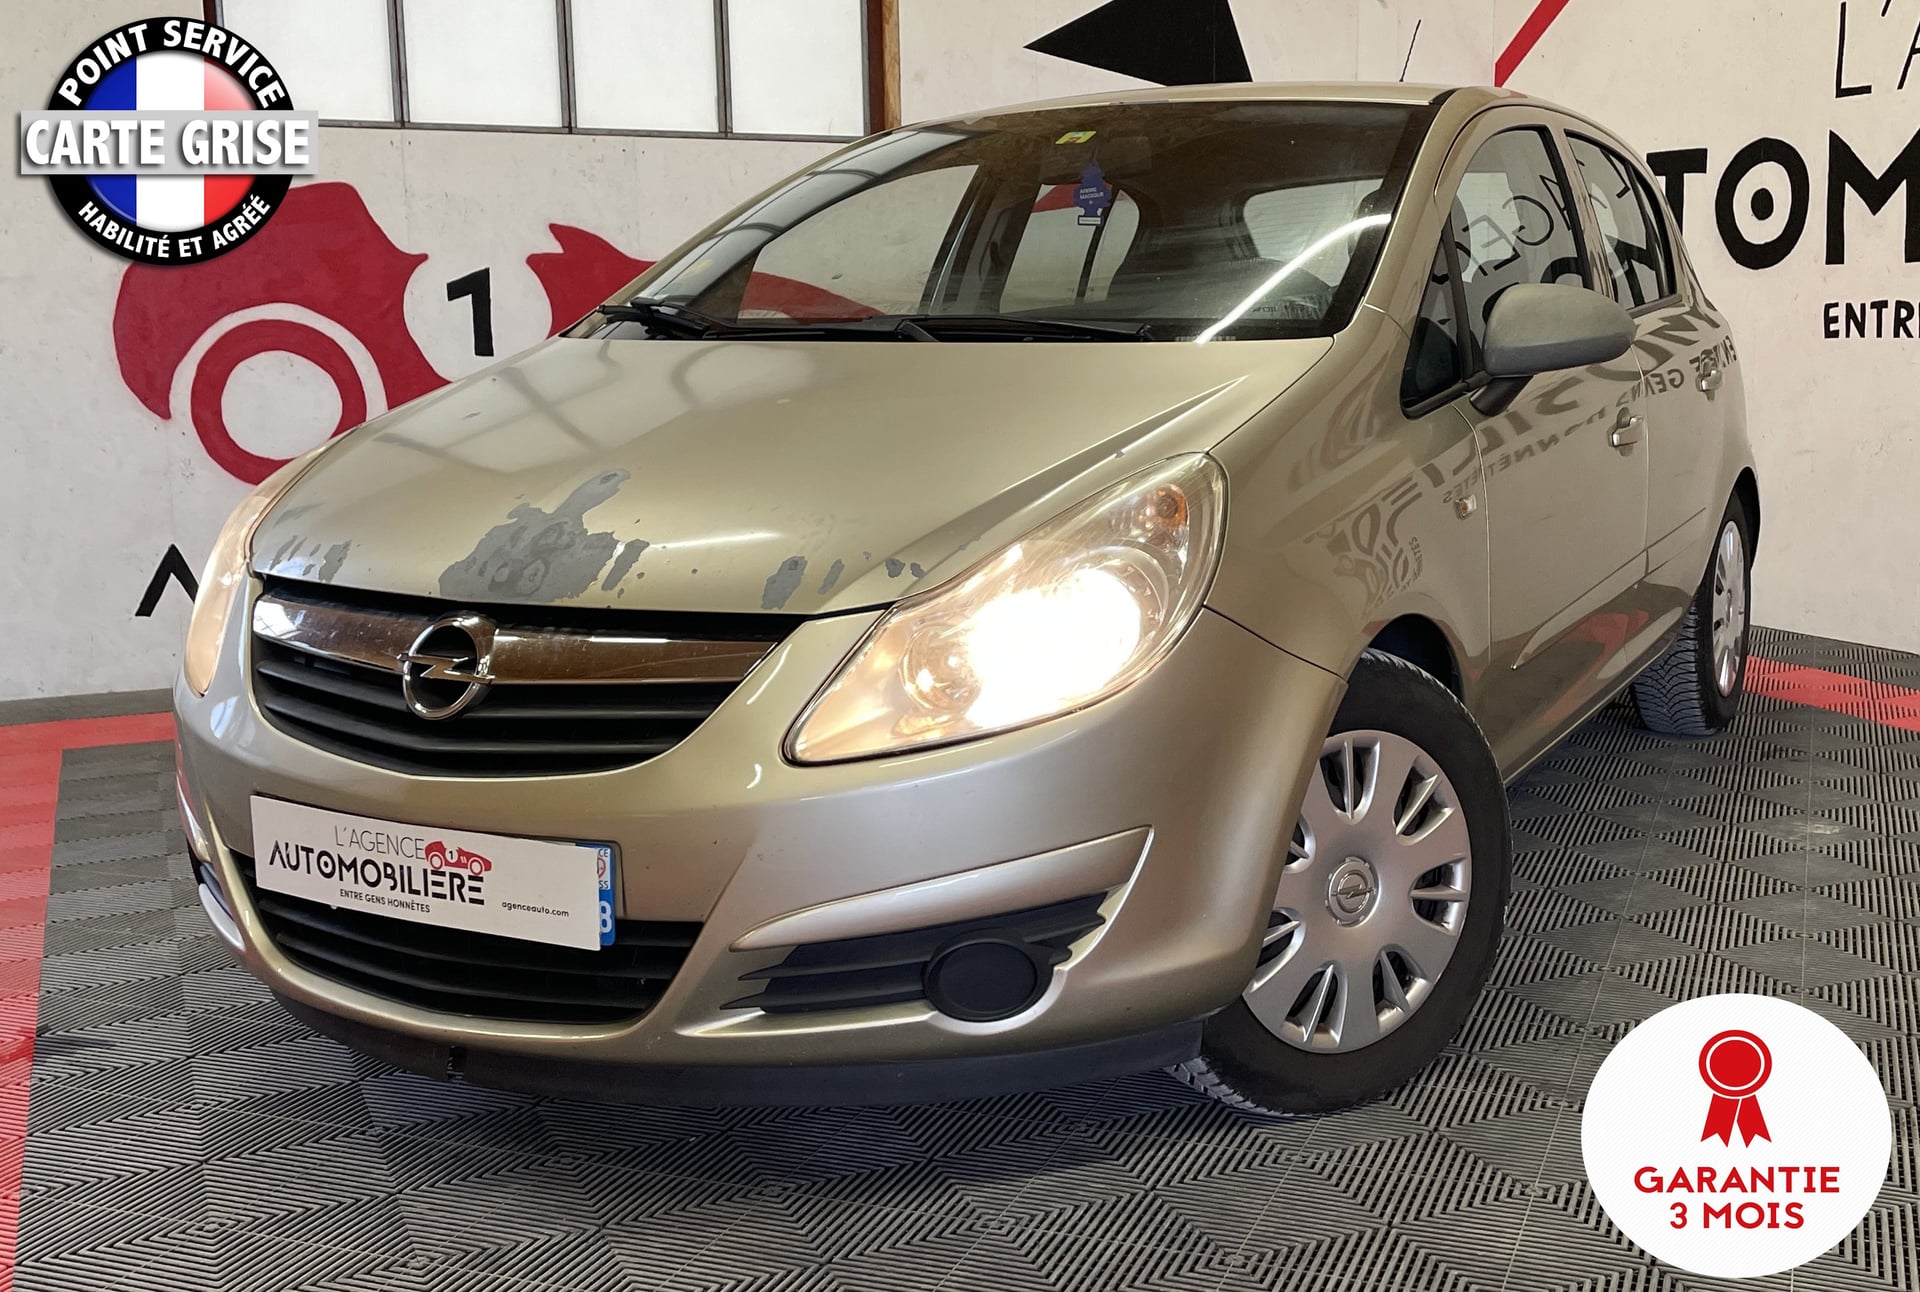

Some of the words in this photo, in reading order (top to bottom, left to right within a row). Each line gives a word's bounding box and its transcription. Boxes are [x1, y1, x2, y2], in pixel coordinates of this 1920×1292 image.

[446, 267, 495, 357] 1
[1823, 299, 1920, 340] ENTR
[334, 825, 426, 861] L'AGENCE
[340, 888, 364, 901] ENTRE
[365, 893, 386, 906] GENS
[387, 895, 431, 914] HONNÊTES
[501, 901, 570, 918] agenceauto.com
